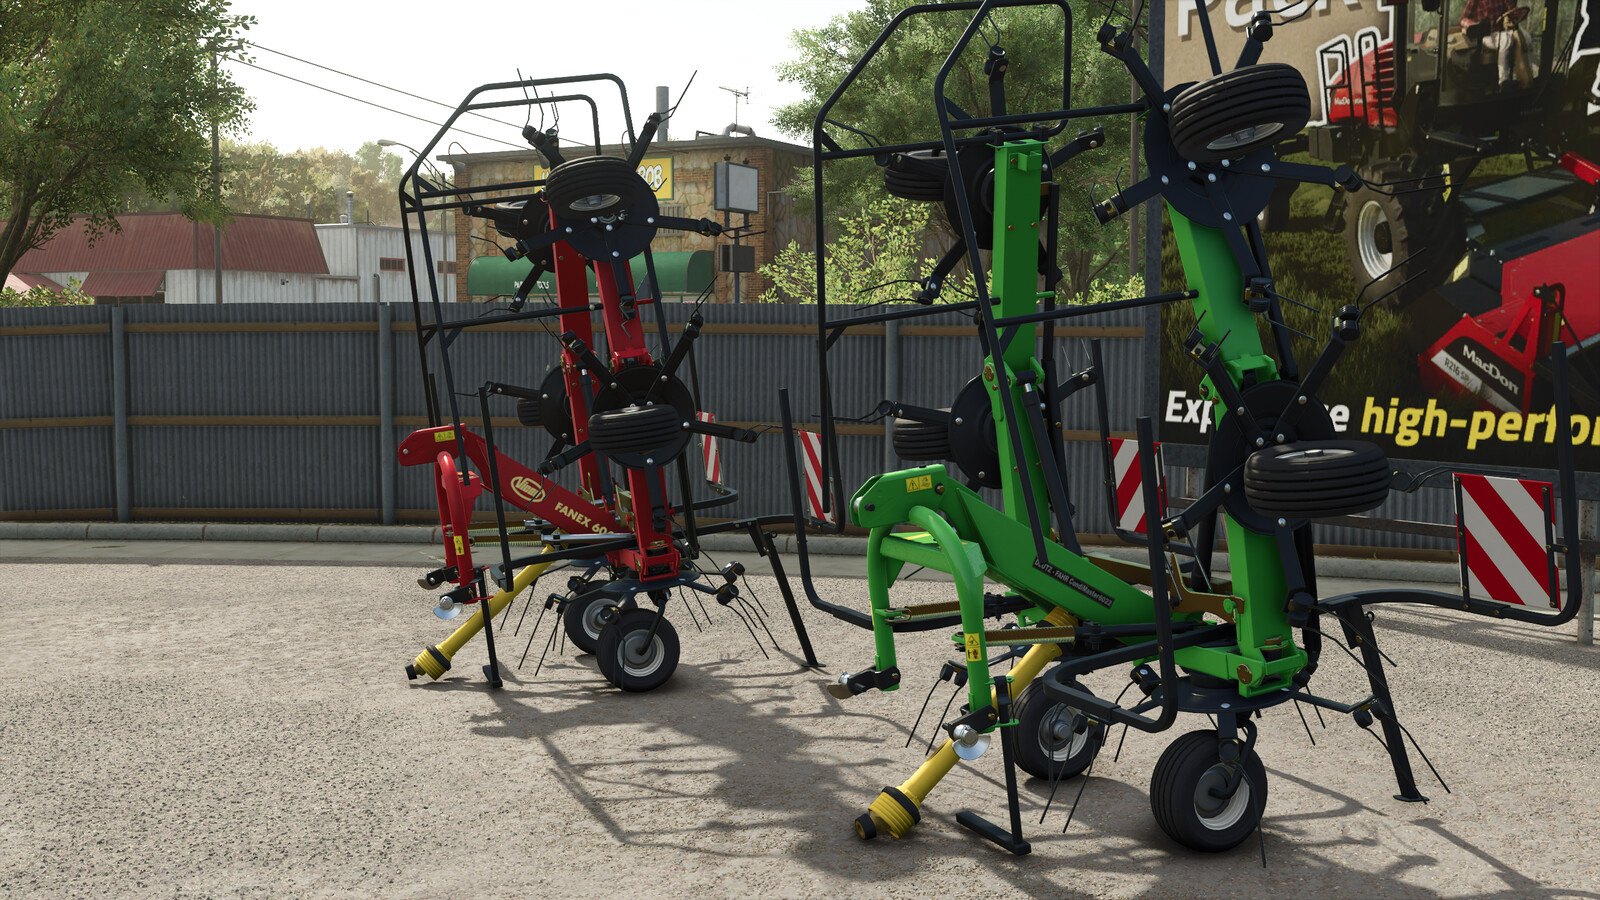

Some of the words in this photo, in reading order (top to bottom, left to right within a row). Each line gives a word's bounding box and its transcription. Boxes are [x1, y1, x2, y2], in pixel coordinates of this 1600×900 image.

[1444, 357, 1460, 376] R216
[1463, 344, 1519, 395] MacDon
[554, 502, 592, 528] FANEX
[592, 523, 614, 534] 60
[1034, 559, 1053, 574] DUTZ
[1054, 570, 1070, 583] FAHR
